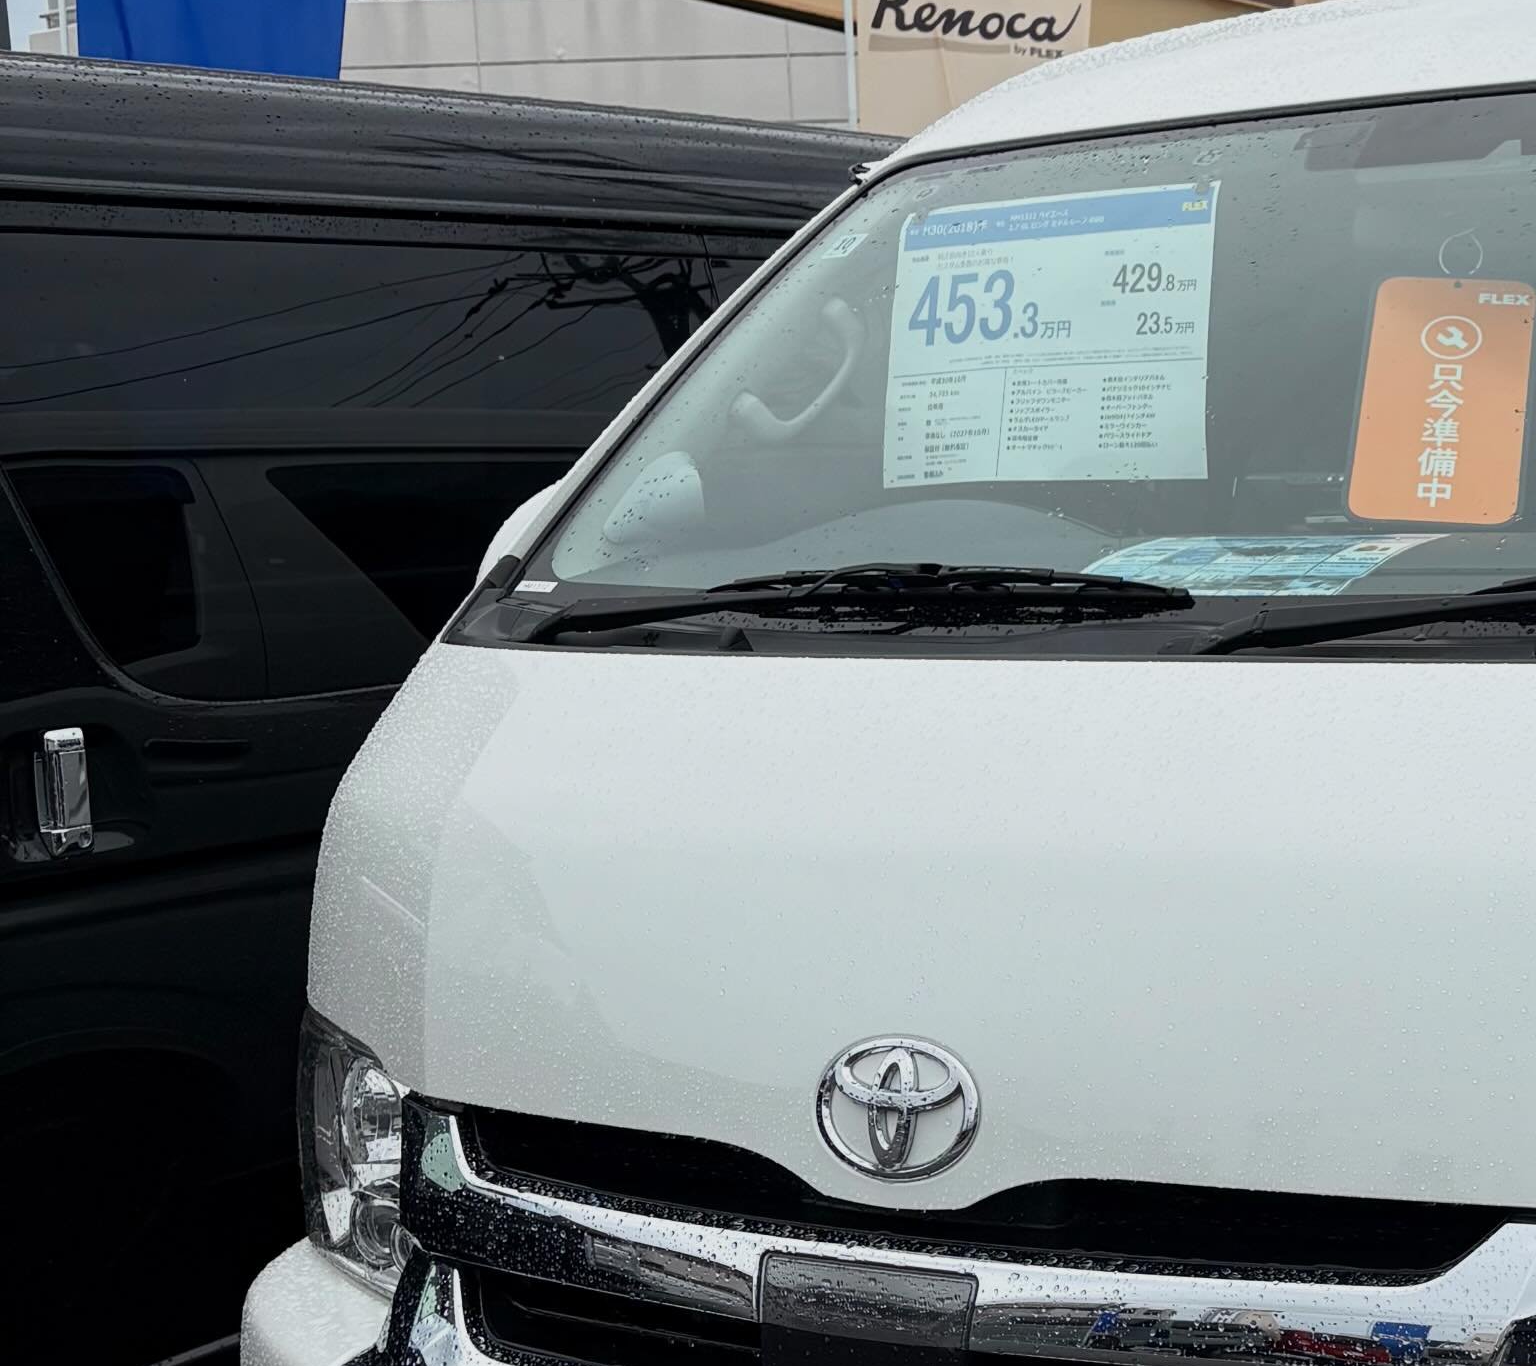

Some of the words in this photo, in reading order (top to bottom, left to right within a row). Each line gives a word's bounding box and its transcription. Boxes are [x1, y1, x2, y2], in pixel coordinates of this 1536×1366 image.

[1013, 43, 1027, 56] by
[1029, 46, 1064, 59] FLEX
[1478, 292, 1531, 306] FLEX
[1416, 363, 1465, 508] 只今準備中
